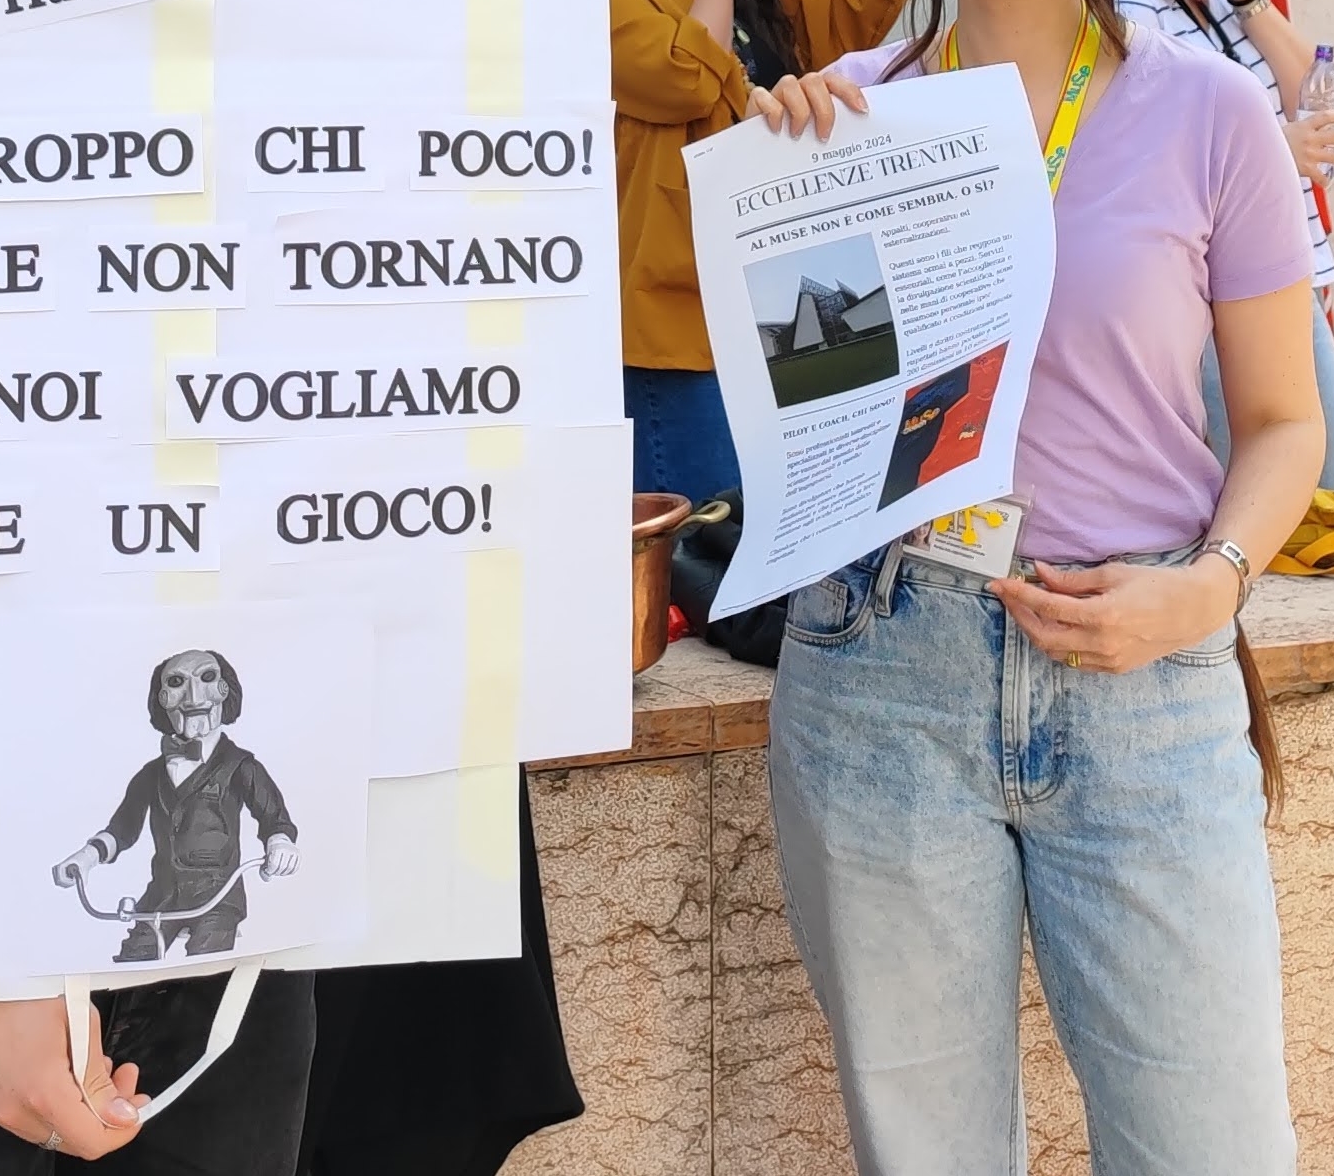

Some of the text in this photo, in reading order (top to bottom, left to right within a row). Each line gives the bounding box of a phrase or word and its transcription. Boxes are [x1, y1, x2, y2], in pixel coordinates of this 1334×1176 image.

[256, 126, 365, 174] CHI
[419, 130, 592, 177] POCO!
[736, 134, 987, 217] ECCELLENZE TRENTINE
[811, 134, 892, 163] 9 maggio 2024
[750, 236, 767, 251] AL
[769, 227, 808, 246] MUSE
[811, 218, 840, 235] NON
[845, 214, 853, 226] È
[856, 205, 895, 223] COME
[961, 186, 971, 196] O
[975, 180, 995, 194] SÌ?
[98, 243, 239, 292] NON
[284, 236, 582, 290] TORNANO
[889, 258, 914, 270] Questi
[953, 244, 967, 253] che
[177, 366, 520, 423] VOGLIAMO
[106, 503, 205, 554] UN
[277, 484, 491, 544] GIOCO!
